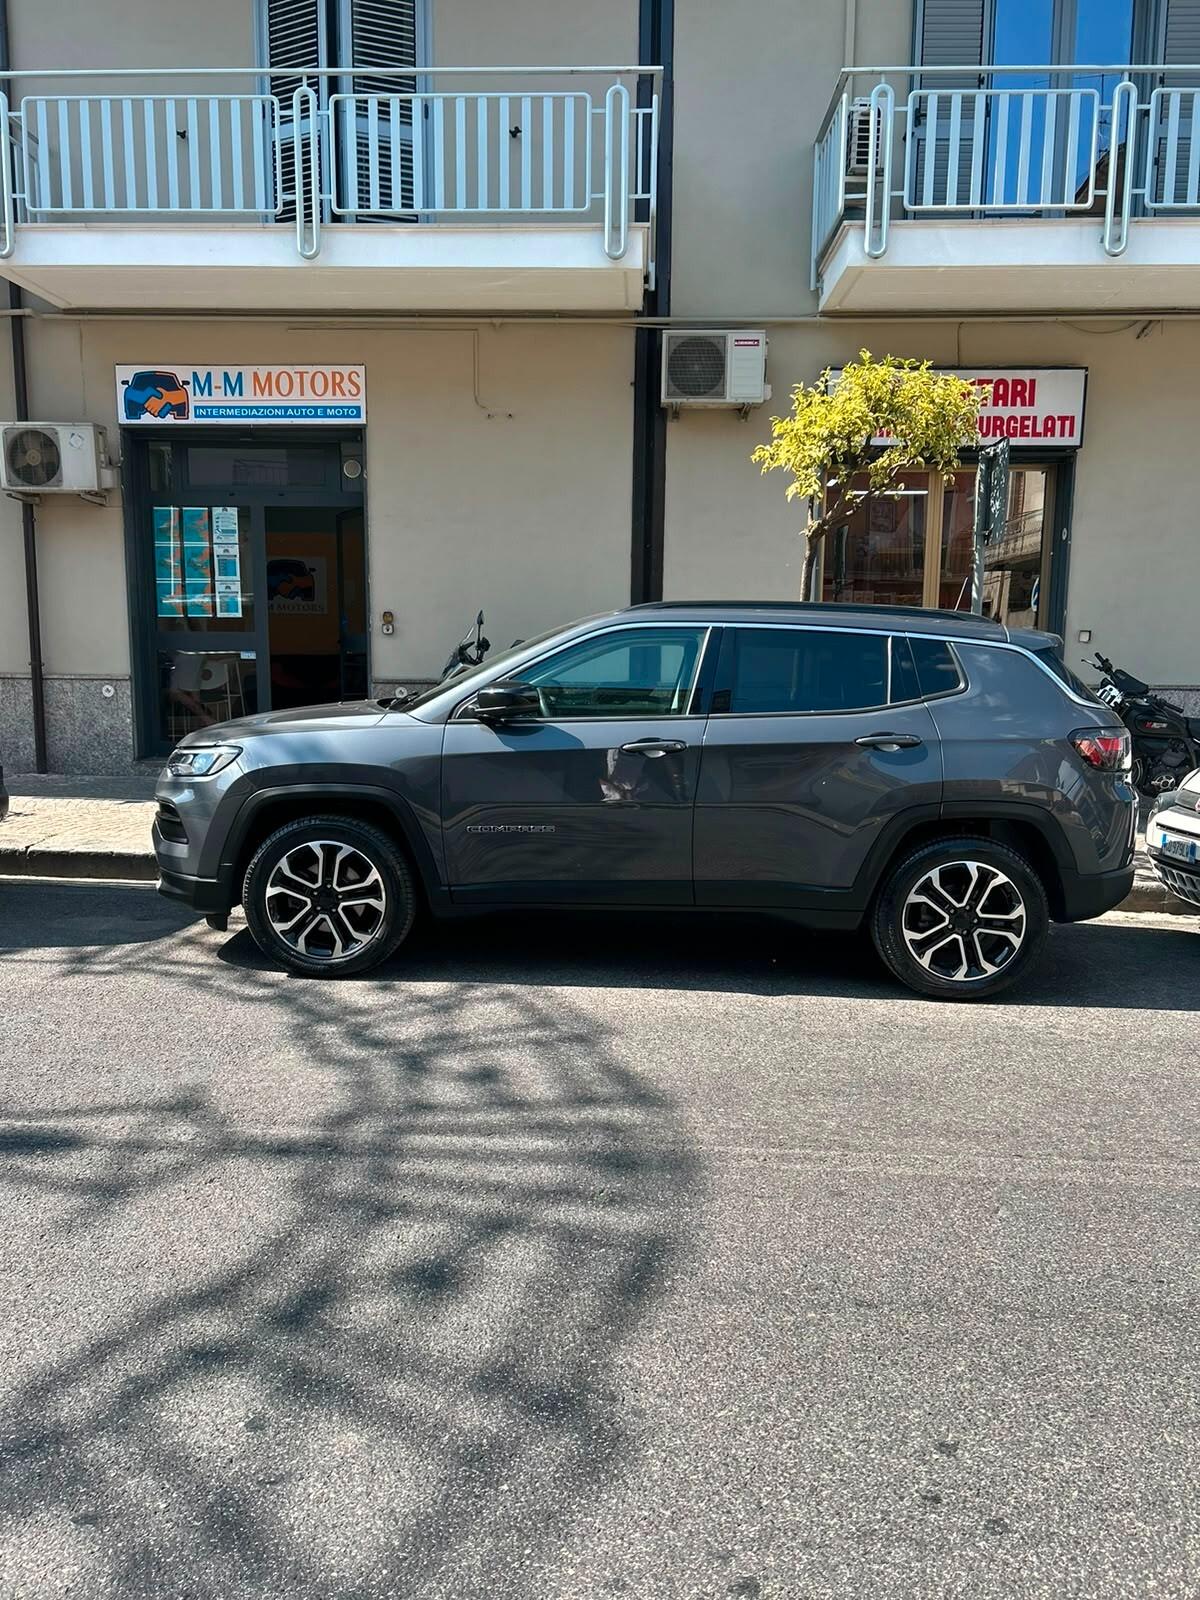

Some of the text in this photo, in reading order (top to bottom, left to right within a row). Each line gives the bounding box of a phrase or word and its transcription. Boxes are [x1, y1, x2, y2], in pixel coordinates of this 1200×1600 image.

[192, 370, 361, 397] M-M MOTORS
[196, 408, 357, 417] INTERMEDIAZIONI AUTO E MOTO
[975, 415, 1075, 438] URGELATI
[466, 825, 556, 833] COMPASS
